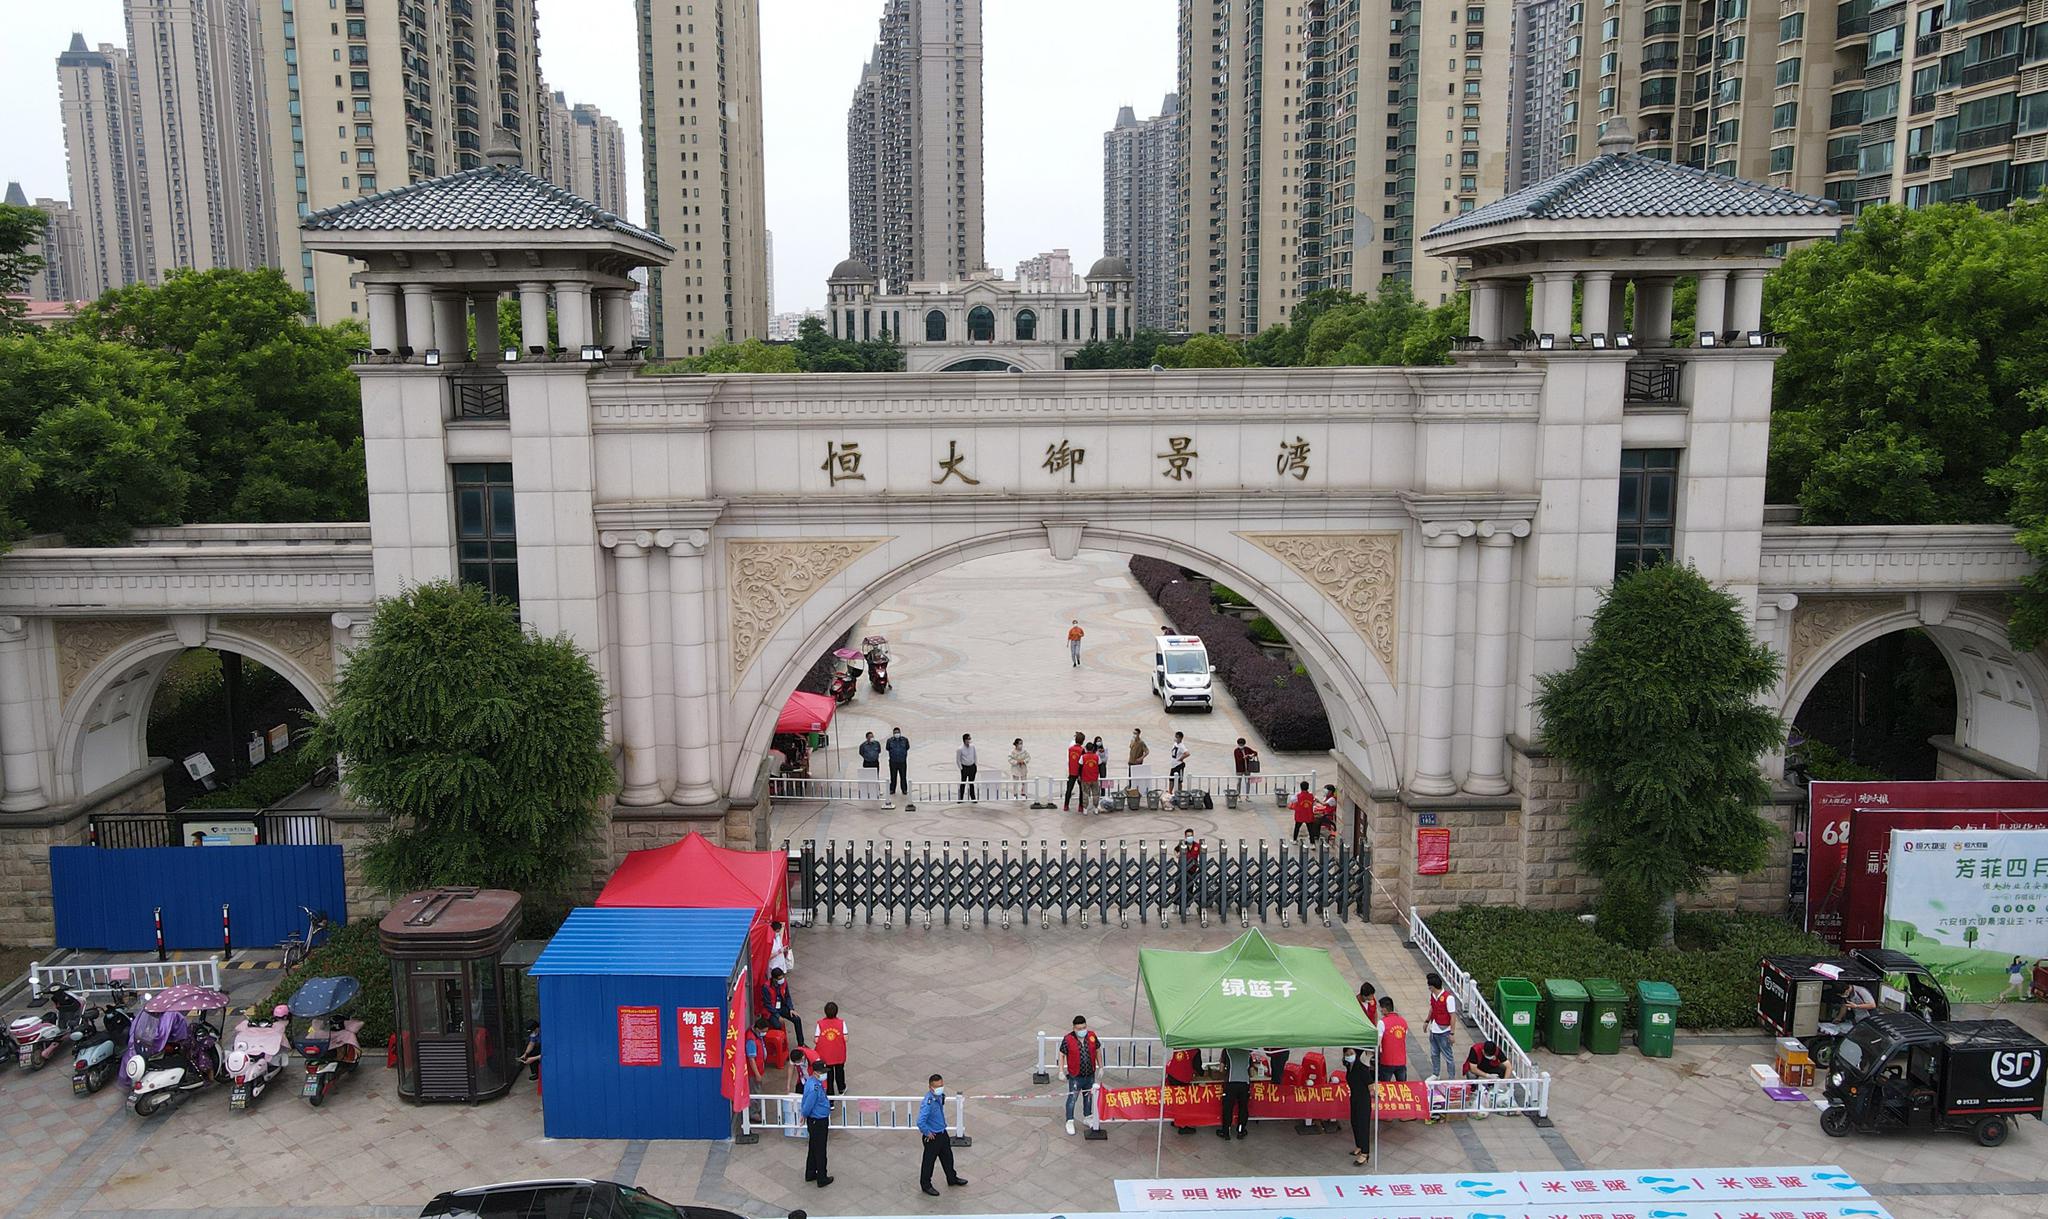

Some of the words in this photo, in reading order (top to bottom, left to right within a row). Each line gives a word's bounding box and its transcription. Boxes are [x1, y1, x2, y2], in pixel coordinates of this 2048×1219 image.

[821, 436, 1311, 487] 恒大御景湾
[1221, 978, 1297, 997] 绿篮子
[682, 1011, 715, 1025] 物资
[692, 1025, 707, 1065] 转运站
[1335, 1183, 1447, 1197] 一米隔离
[1518, 1179, 1631, 1192] 一米隔离
[1691, 1176, 1808, 1190] 一米隔离
[1147, 1186, 1310, 1200] 测温等待区
